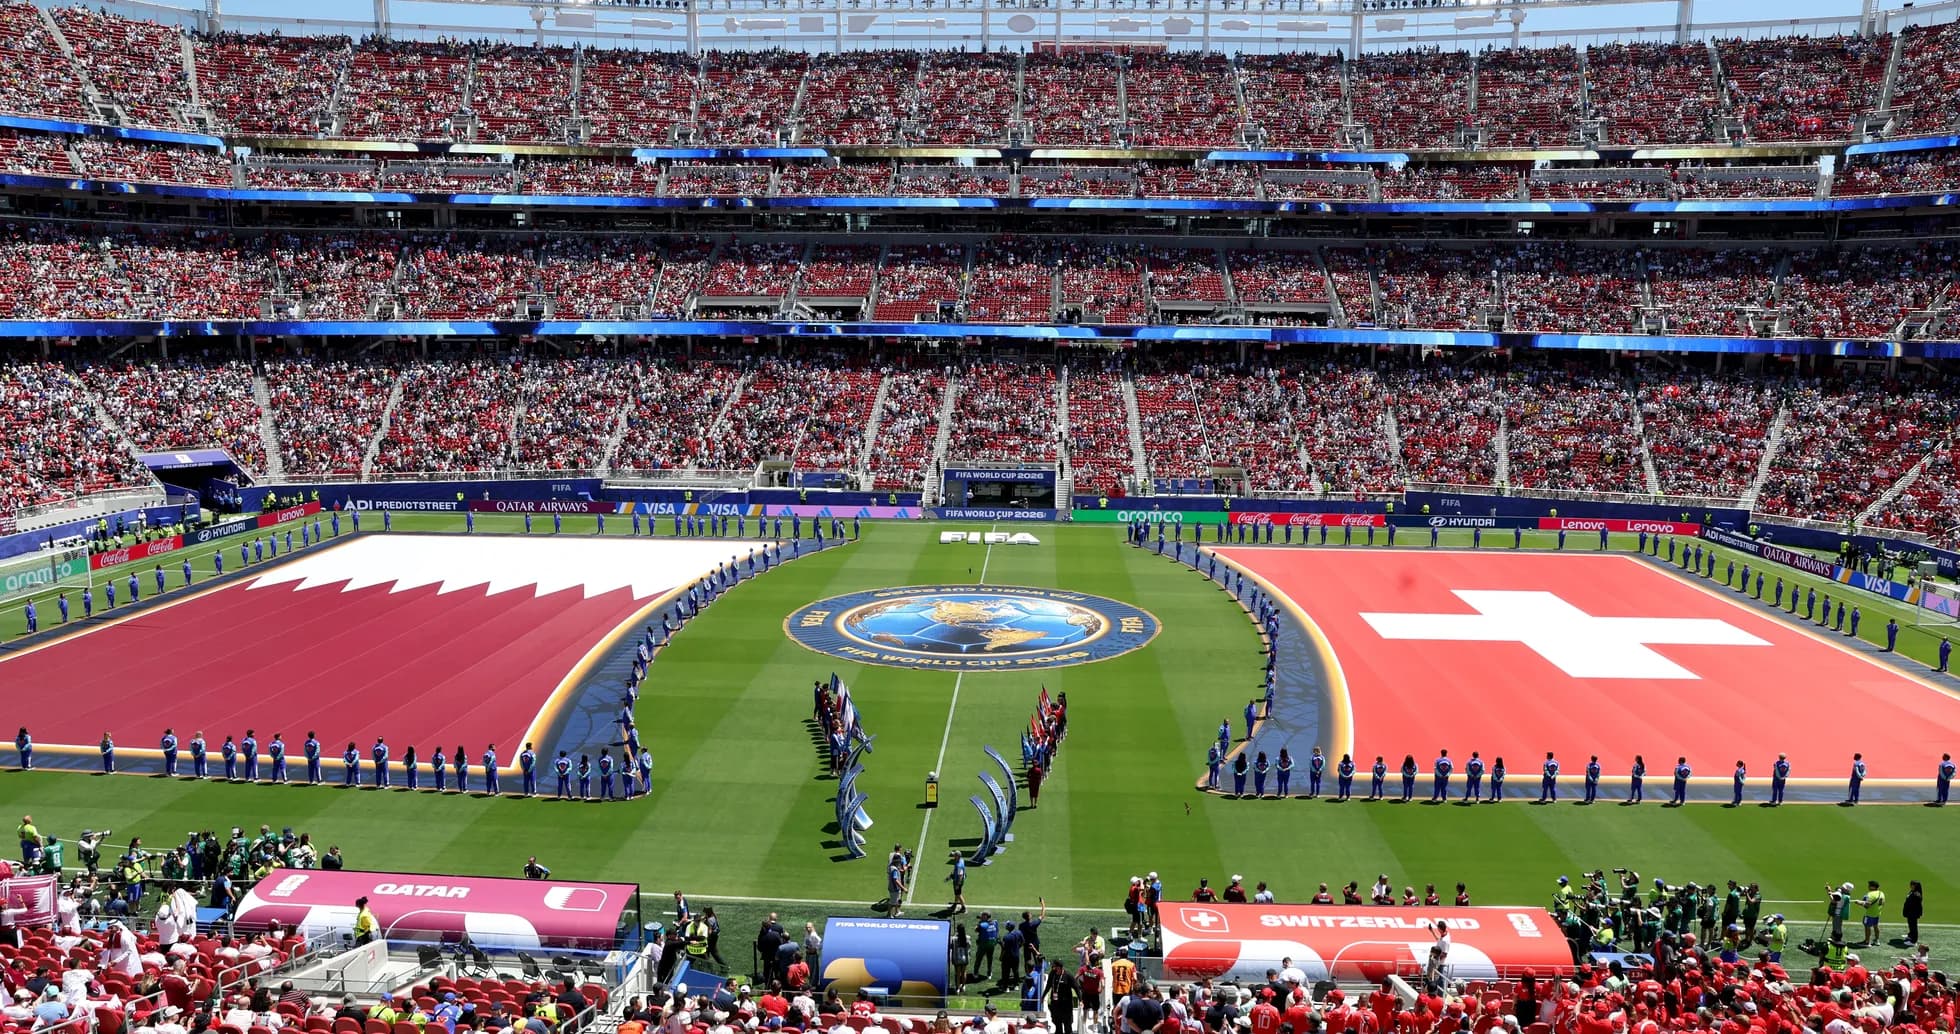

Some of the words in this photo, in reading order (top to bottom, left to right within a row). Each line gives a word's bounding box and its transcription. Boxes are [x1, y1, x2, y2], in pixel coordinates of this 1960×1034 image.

[956, 471, 972, 479] FIFA
[972, 471, 1000, 479] WORLD
[1017, 472, 1044, 480] 2026
[552, 484, 572, 492] FIFA
[343, 500, 372, 511] ADI
[375, 501, 458, 510] PREDICTSTREET
[496, 501, 535, 512] QATAR
[540, 502, 588, 512] AIRWAYS
[642, 503, 675, 514] VISA
[1441, 499, 1461, 507] FIFA
[277, 508, 305, 523] Lenovo
[707, 504, 740, 515] VISA
[945, 510, 964, 518] FIFA
[964, 510, 995, 518] WORLD
[1014, 511, 1044, 519] 2026
[1117, 510, 1183, 522] aramco
[1449, 518, 1496, 527] HYUNDAI
[1561, 519, 1605, 530] Lenovo
[1627, 520, 1674, 533] Lenovo
[213, 521, 246, 538] HYUNDAI
[939, 531, 1041, 545] FIFA
[1705, 529, 1719, 540] ADI
[1718, 534, 1760, 553] PREDICTSTREET
[1763, 545, 1791, 564] QATAR
[1794, 555, 1831, 577] AIRWAYS
[1937, 557, 1954, 569] FIFA
[1863, 573, 1891, 596] VISA
[801, 610, 831, 627] FIFA
[1119, 616, 1145, 634] FIFA
[838, 646, 879, 659] FIFA
[881, 655, 962, 666] WORLD
[966, 658, 1011, 667] CUP
[1017, 651, 1090, 665] 2026
[373, 883, 471, 899] QATAR
[1260, 914, 1480, 930] SWITZERLAND
